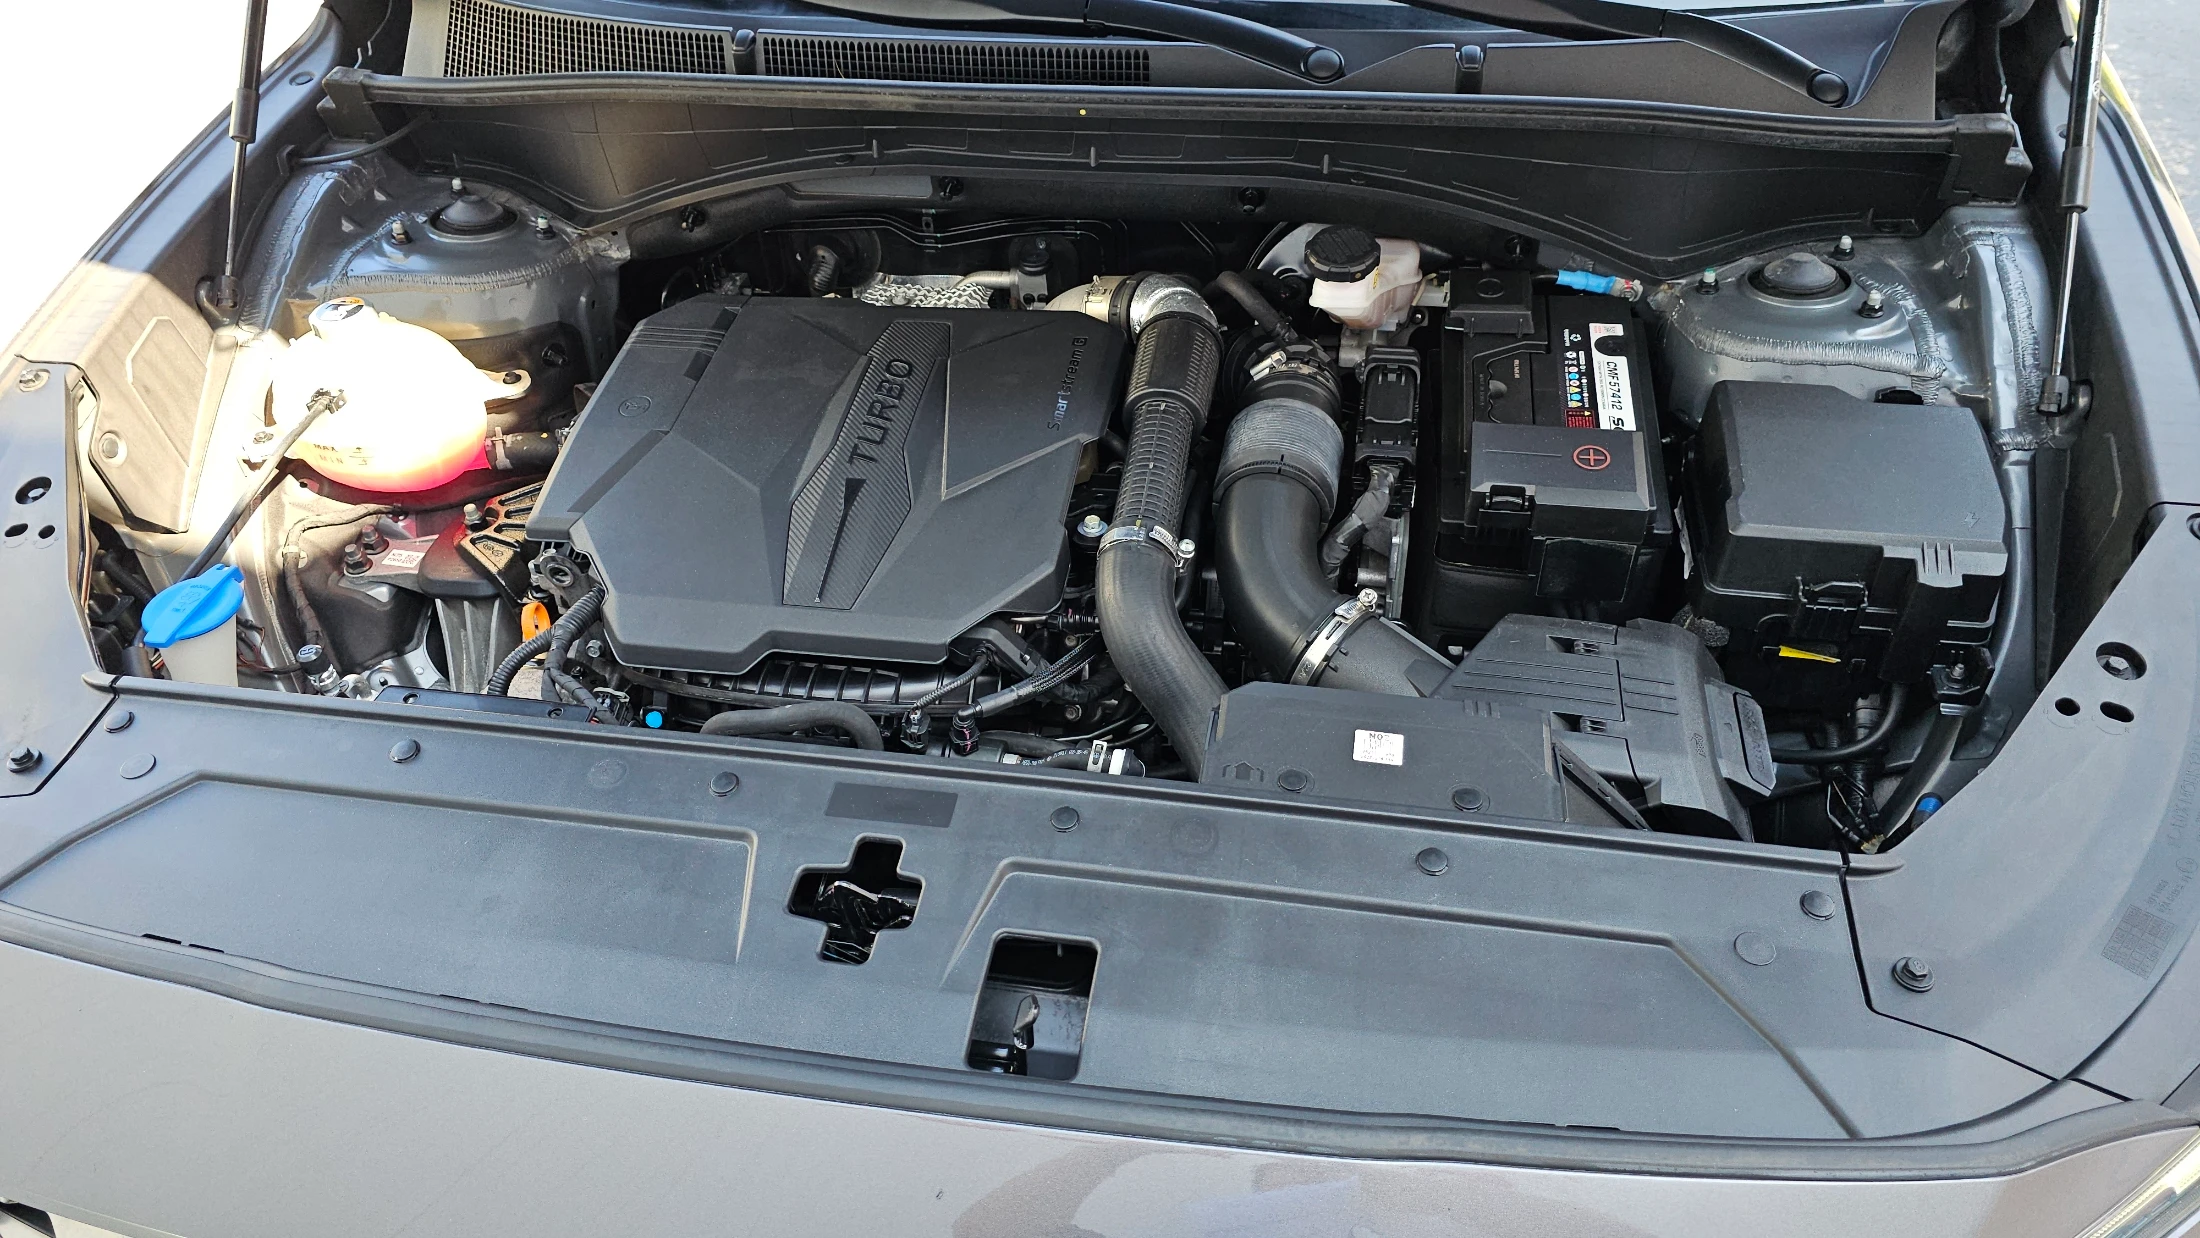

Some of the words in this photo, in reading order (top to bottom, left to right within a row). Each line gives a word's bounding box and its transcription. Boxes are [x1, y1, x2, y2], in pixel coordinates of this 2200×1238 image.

[847, 358, 913, 466] TURBO
[1047, 348, 1084, 432] Smartstream
[313, 444, 338, 452] MAX
